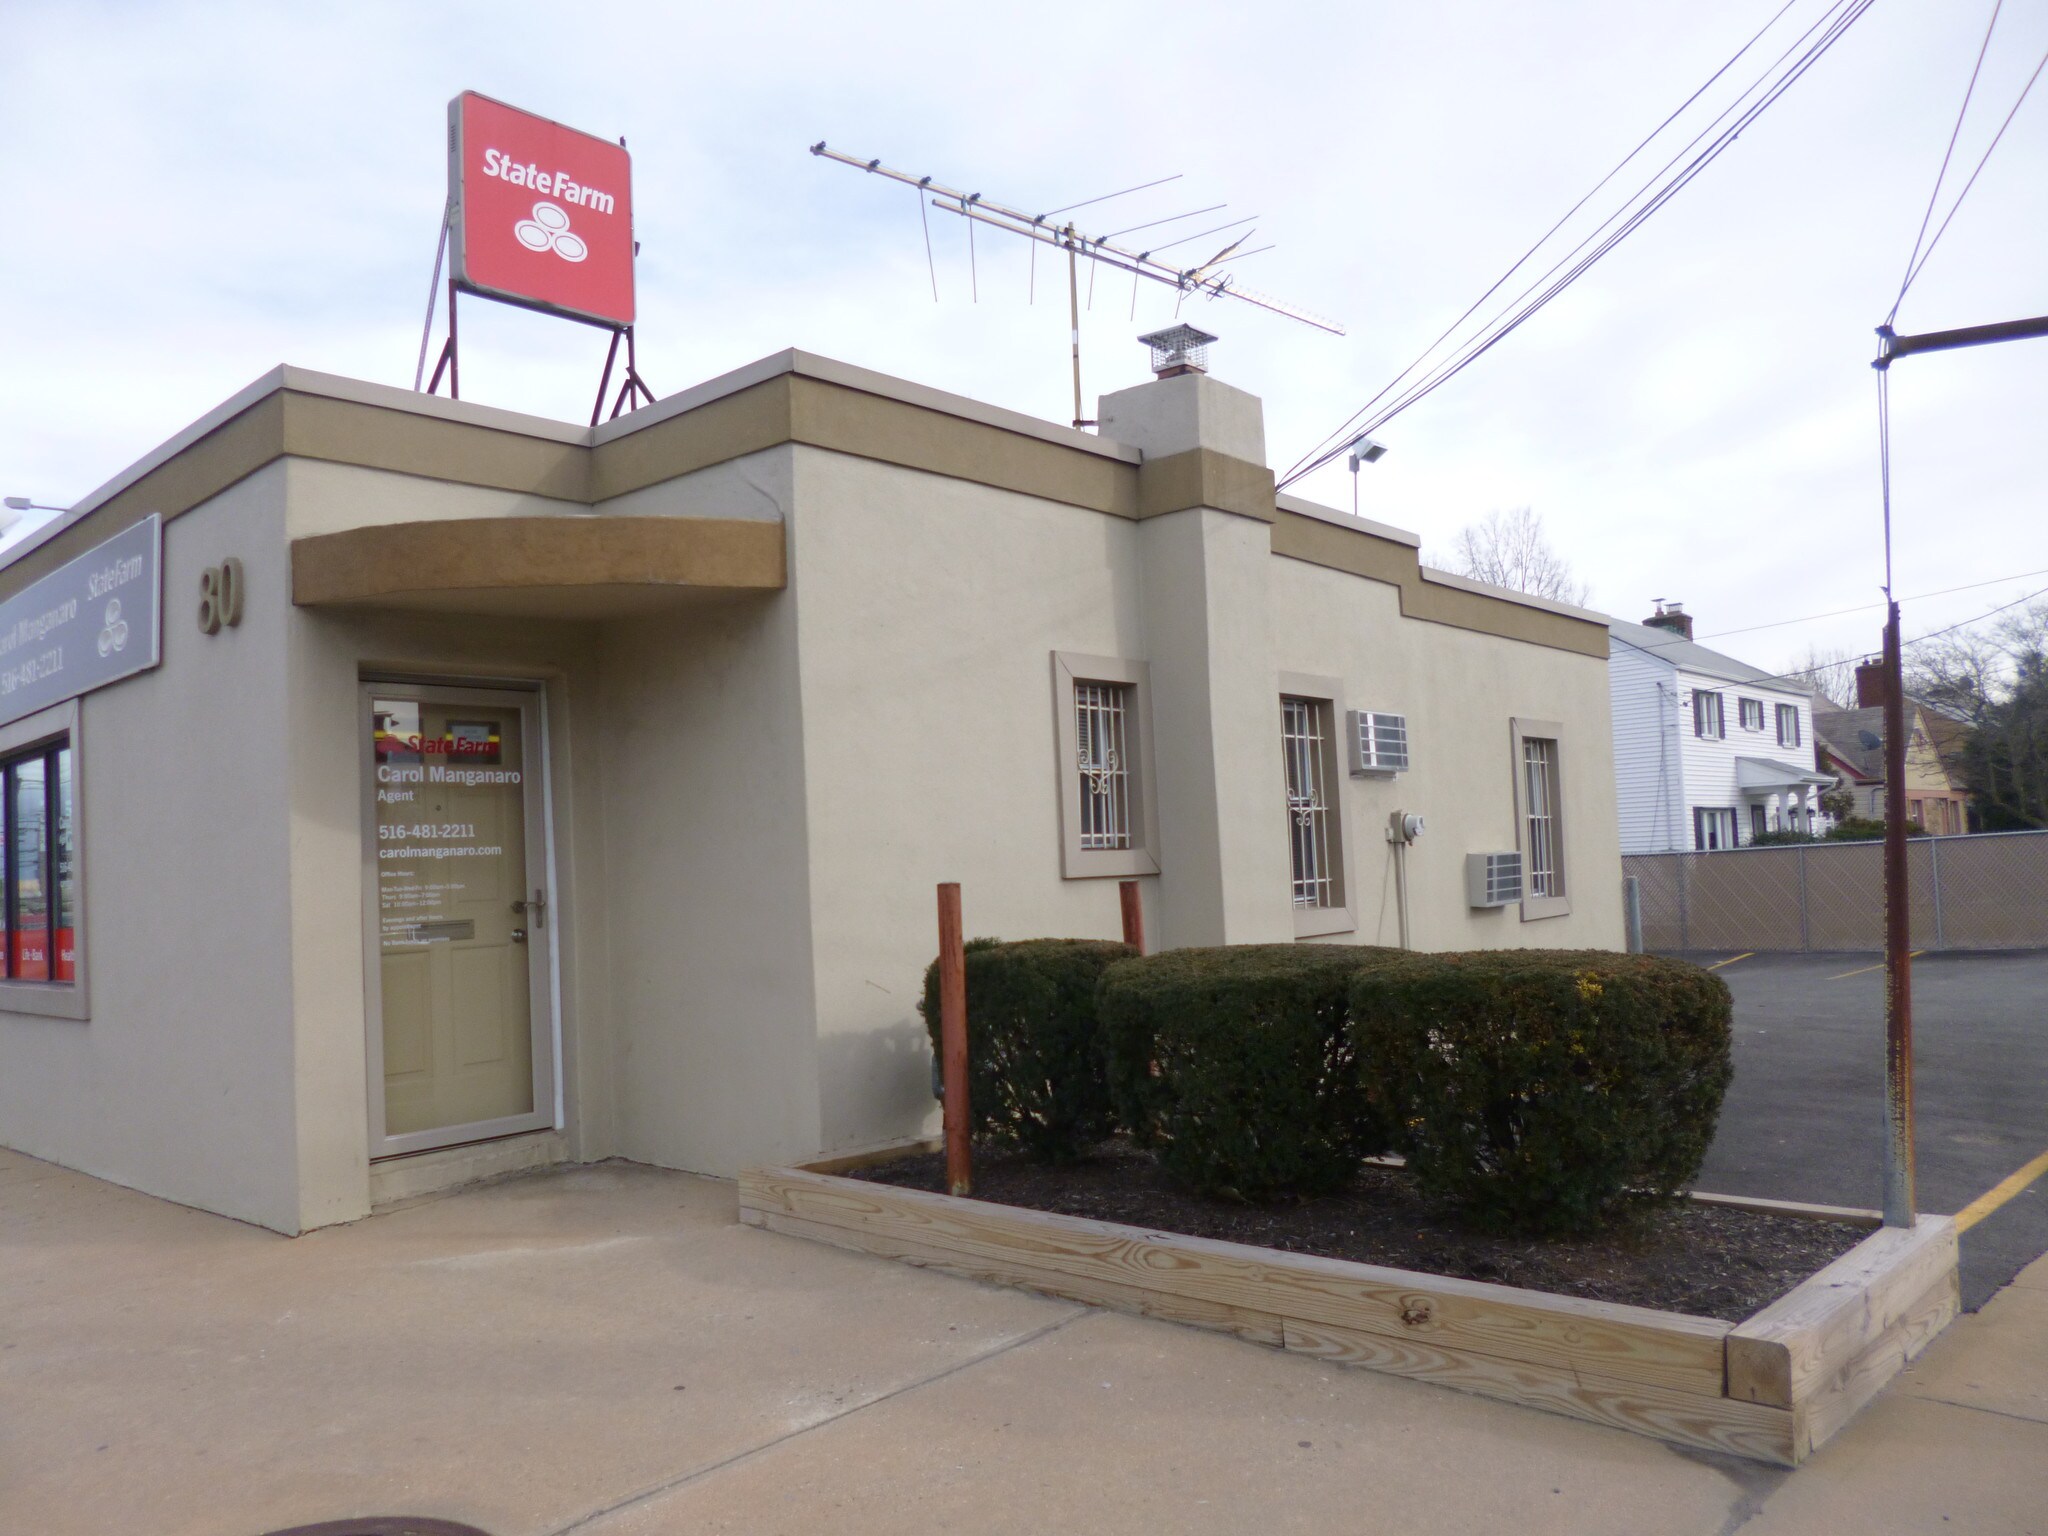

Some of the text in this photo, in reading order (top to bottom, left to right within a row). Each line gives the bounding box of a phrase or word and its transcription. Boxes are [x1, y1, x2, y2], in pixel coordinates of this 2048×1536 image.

[483, 148, 615, 215] StateFarm
[199, 557, 243, 635] 80
[18, 598, 77, 641] Manganaro
[378, 766, 521, 786] Carol Manganaro
[378, 789, 414, 804] Agent
[379, 824, 476, 840] 516-481-2211
[379, 846, 502, 859] carolmanganaro.com
